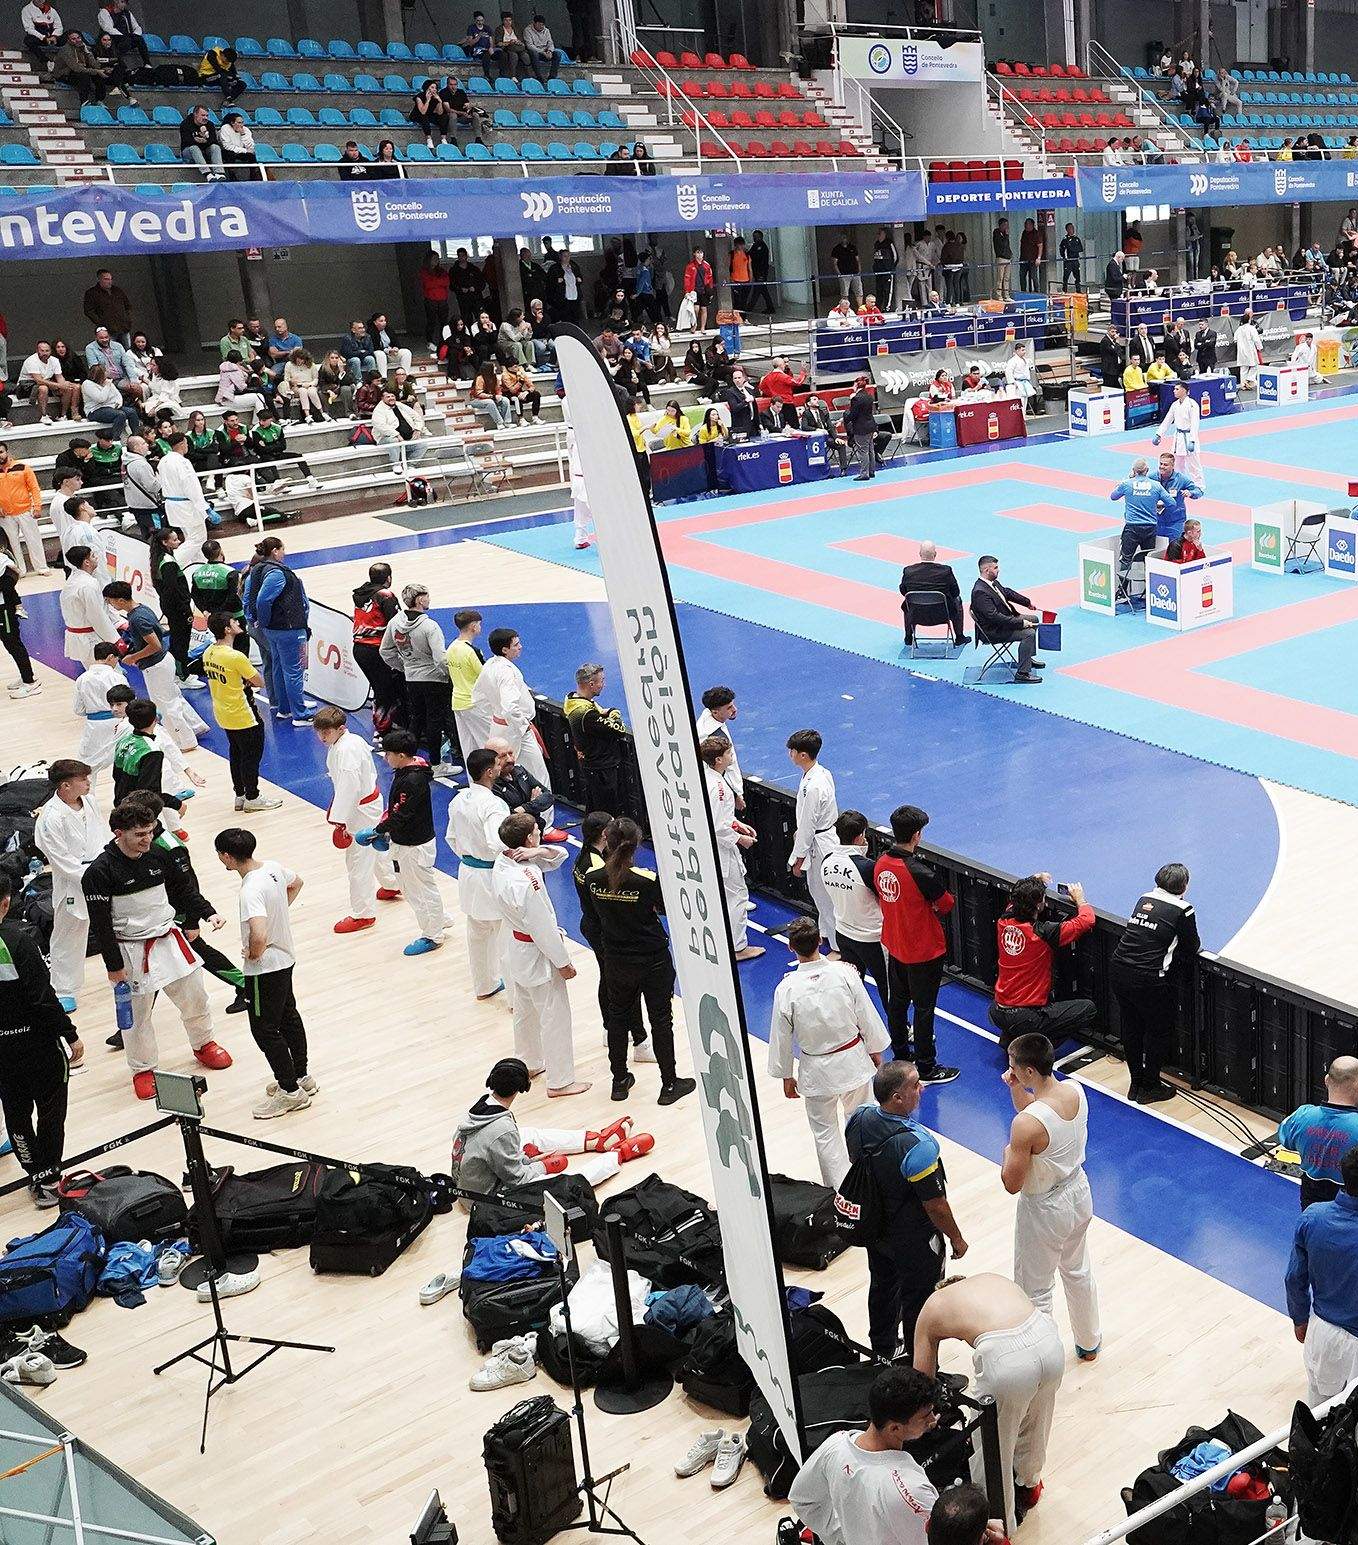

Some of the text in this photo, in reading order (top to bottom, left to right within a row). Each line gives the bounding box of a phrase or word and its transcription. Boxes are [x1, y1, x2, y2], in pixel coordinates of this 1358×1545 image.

[556, 194, 611, 205] Deputación
[701, 194, 731, 203] Concello
[820, 190, 845, 199] XUNTA
[936, 189, 1071, 204] DEPORTE PONTEVEDRA
[385, 202, 423, 211] Concello
[702, 202, 750, 211] de Pontevedra
[821, 198, 859, 207] DE GALICIA
[558, 204, 612, 214] Pontevedra
[386, 210, 448, 221] de Pontevedra
[0, 200, 249, 248] ntevedra
[1227, 380, 1234, 390] 4
[812, 442, 820, 454] 6
[737, 452, 760, 461] rfek.es
[1329, 548, 1355, 565] Daedo
[1150, 593, 1177, 611] Daedo
[824, 864, 856, 883] E.S.K.
[102, 1138, 123, 1152] FGK
[243, 1138, 258, 1148] FGK
[18, 1133, 34, 1164] KARATE
[293, 1151, 308, 1160] FGK
[344, 1163, 359, 1172] FGK
[32, 1169, 53, 1182] FGK
[395, 1175, 411, 1184] FGK
[448, 1188, 463, 1197] FGK
[502, 1200, 517, 1209] FGK
[824, 1328, 839, 1341] FGK
[876, 1354, 892, 1367] FGK
